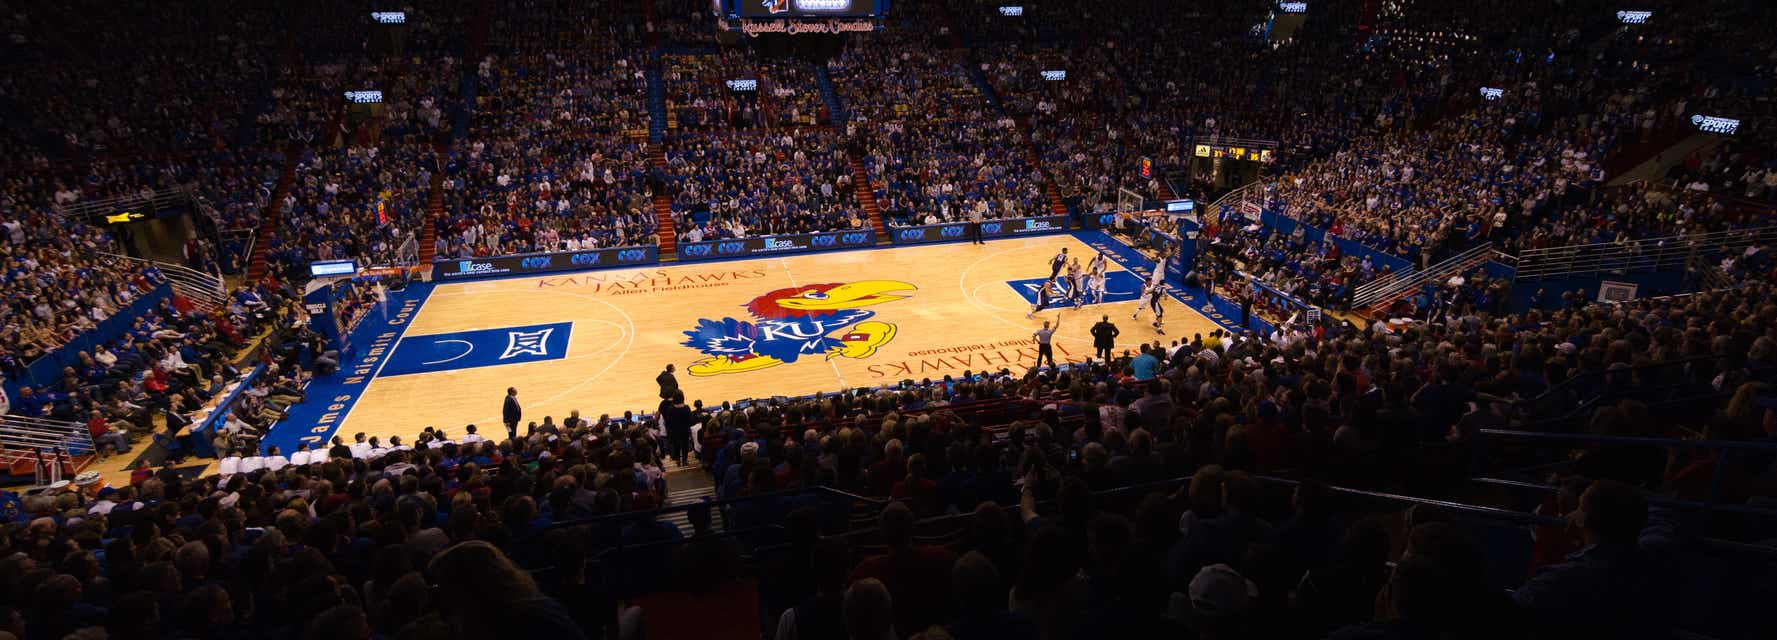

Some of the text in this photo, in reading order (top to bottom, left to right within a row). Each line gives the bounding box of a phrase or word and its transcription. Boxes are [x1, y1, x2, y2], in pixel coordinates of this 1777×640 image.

[740, 18, 874, 37] Russell Stover Candies
[594, 270, 766, 292] JAYHAWKS
[611, 288, 648, 296] Allen
[762, 320, 824, 341] KU
[908, 342, 996, 357] Fieldhouse
[300, 395, 351, 443] James
[342, 332, 397, 385] Naismith
[388, 299, 420, 326] Court
